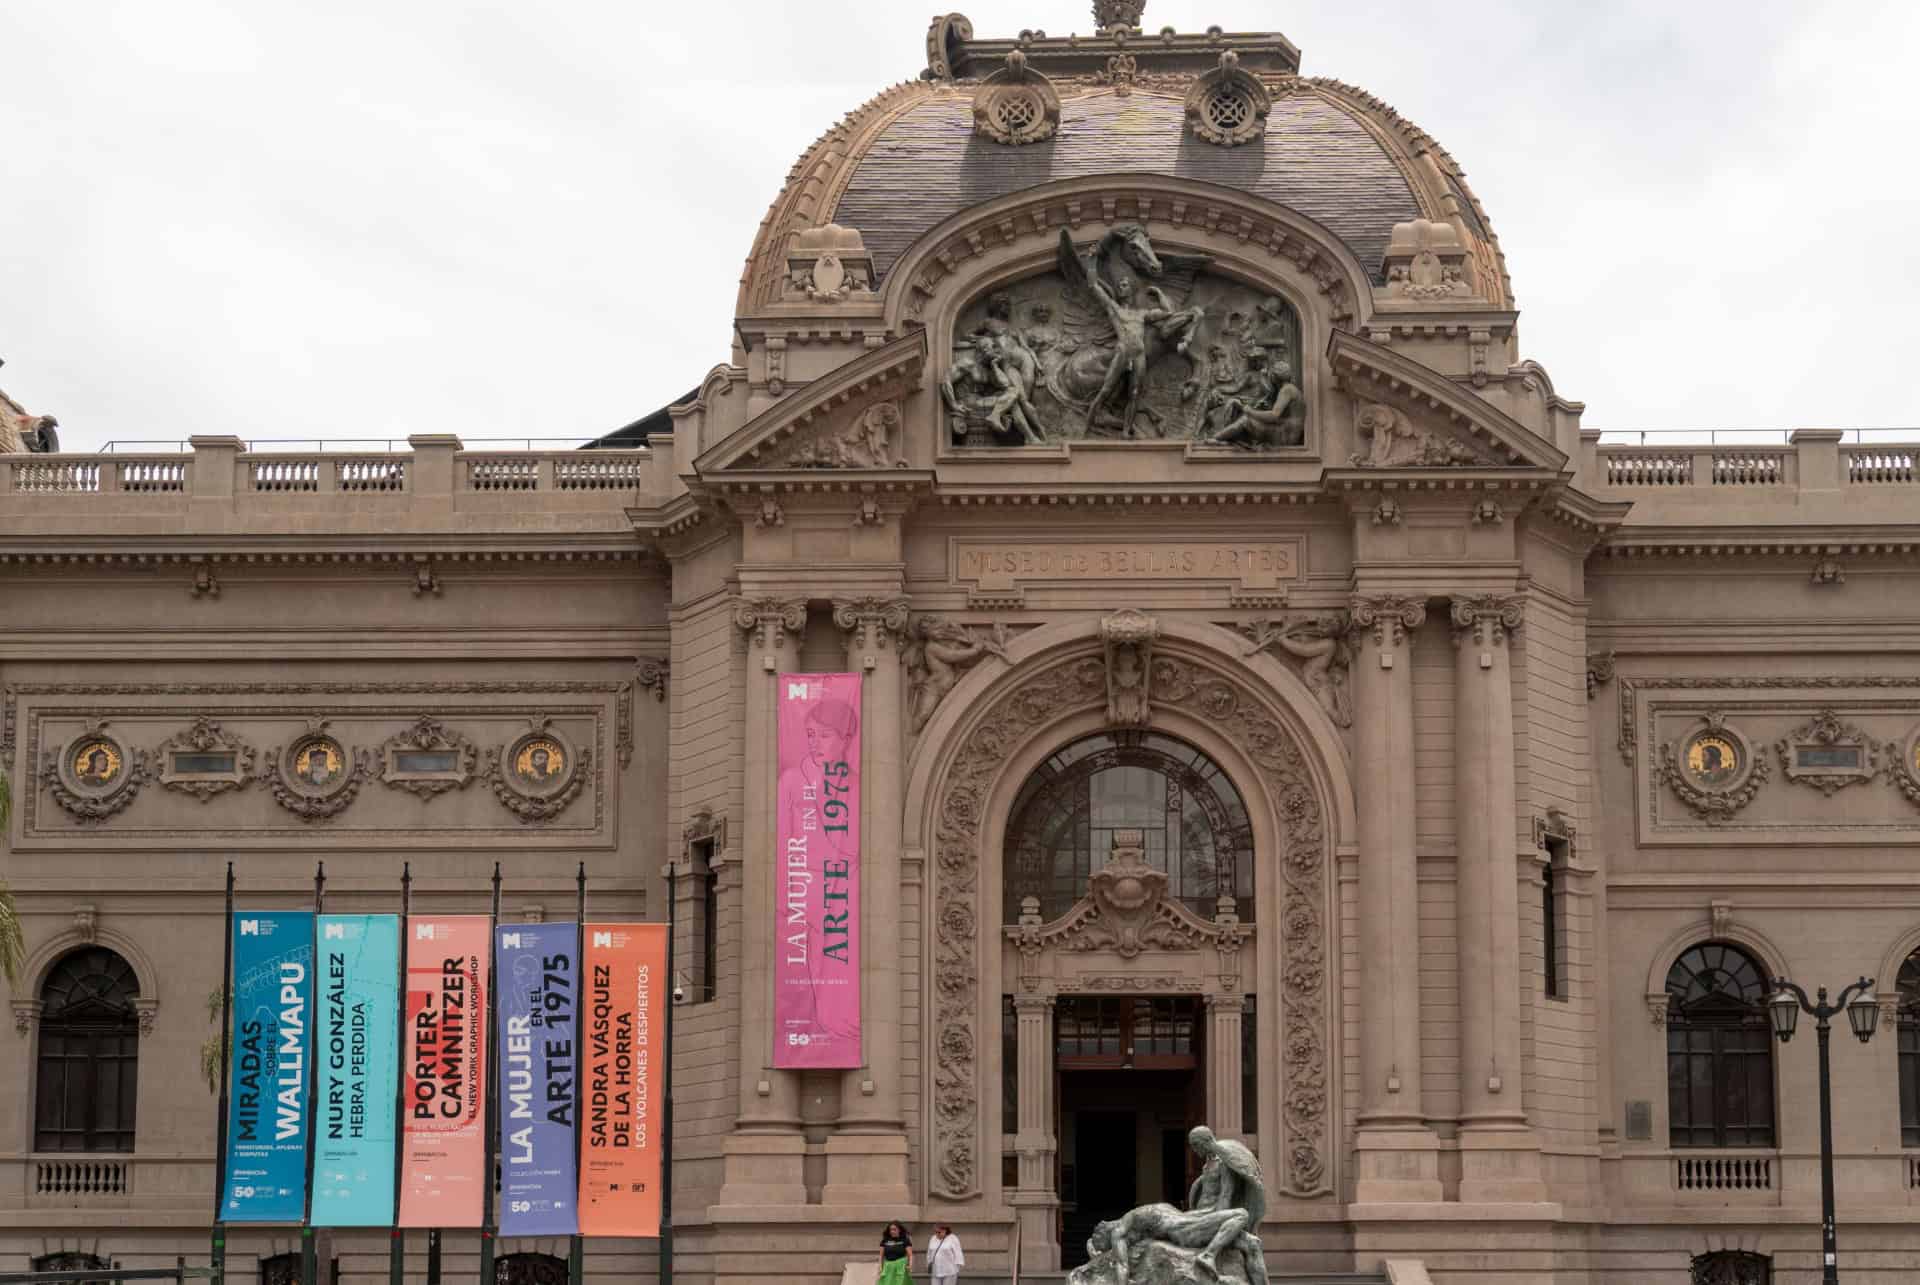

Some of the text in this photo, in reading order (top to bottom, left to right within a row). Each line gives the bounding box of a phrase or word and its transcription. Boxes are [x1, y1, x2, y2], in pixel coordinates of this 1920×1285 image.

[965, 551, 1051, 573] MUSEO
[1100, 551, 1194, 573] BELLAS
[1212, 550, 1289, 572] ARTES
[803, 782, 817, 831] EN EL
[788, 835, 812, 966] LA MUJER
[823, 761, 849, 965] ARTE 1975
[328, 953, 345, 1069] GONZÁLEZ
[470, 955, 479, 1010] WORKSHOP
[531, 987, 543, 1027] EN EL
[590, 965, 613, 1058] VÁSQUEZ
[265, 1023, 277, 1077] SOBRE EL
[275, 963, 304, 1141] WALLMAPU
[350, 1003, 365, 1138] HEBRA PERDIDA
[441, 956, 465, 1119] CAMNITZER
[469, 1057, 477, 1081] YORK
[470, 1012, 478, 1053] GRAPHIC
[507, 1015, 533, 1119] MUJER
[543, 954, 572, 1127] ARTE 1975
[635, 965, 649, 1149] LOS VOLCANES DESPIERTOS
[238, 1021, 261, 1140] MIRADAS
[328, 1073, 344, 1139] NURY
[469, 1084, 477, 1106] NEW
[591, 1063, 608, 1147] SANDRA
[614, 1012, 632, 1147] DE LA HORRA
[510, 1126, 533, 1164] LA
